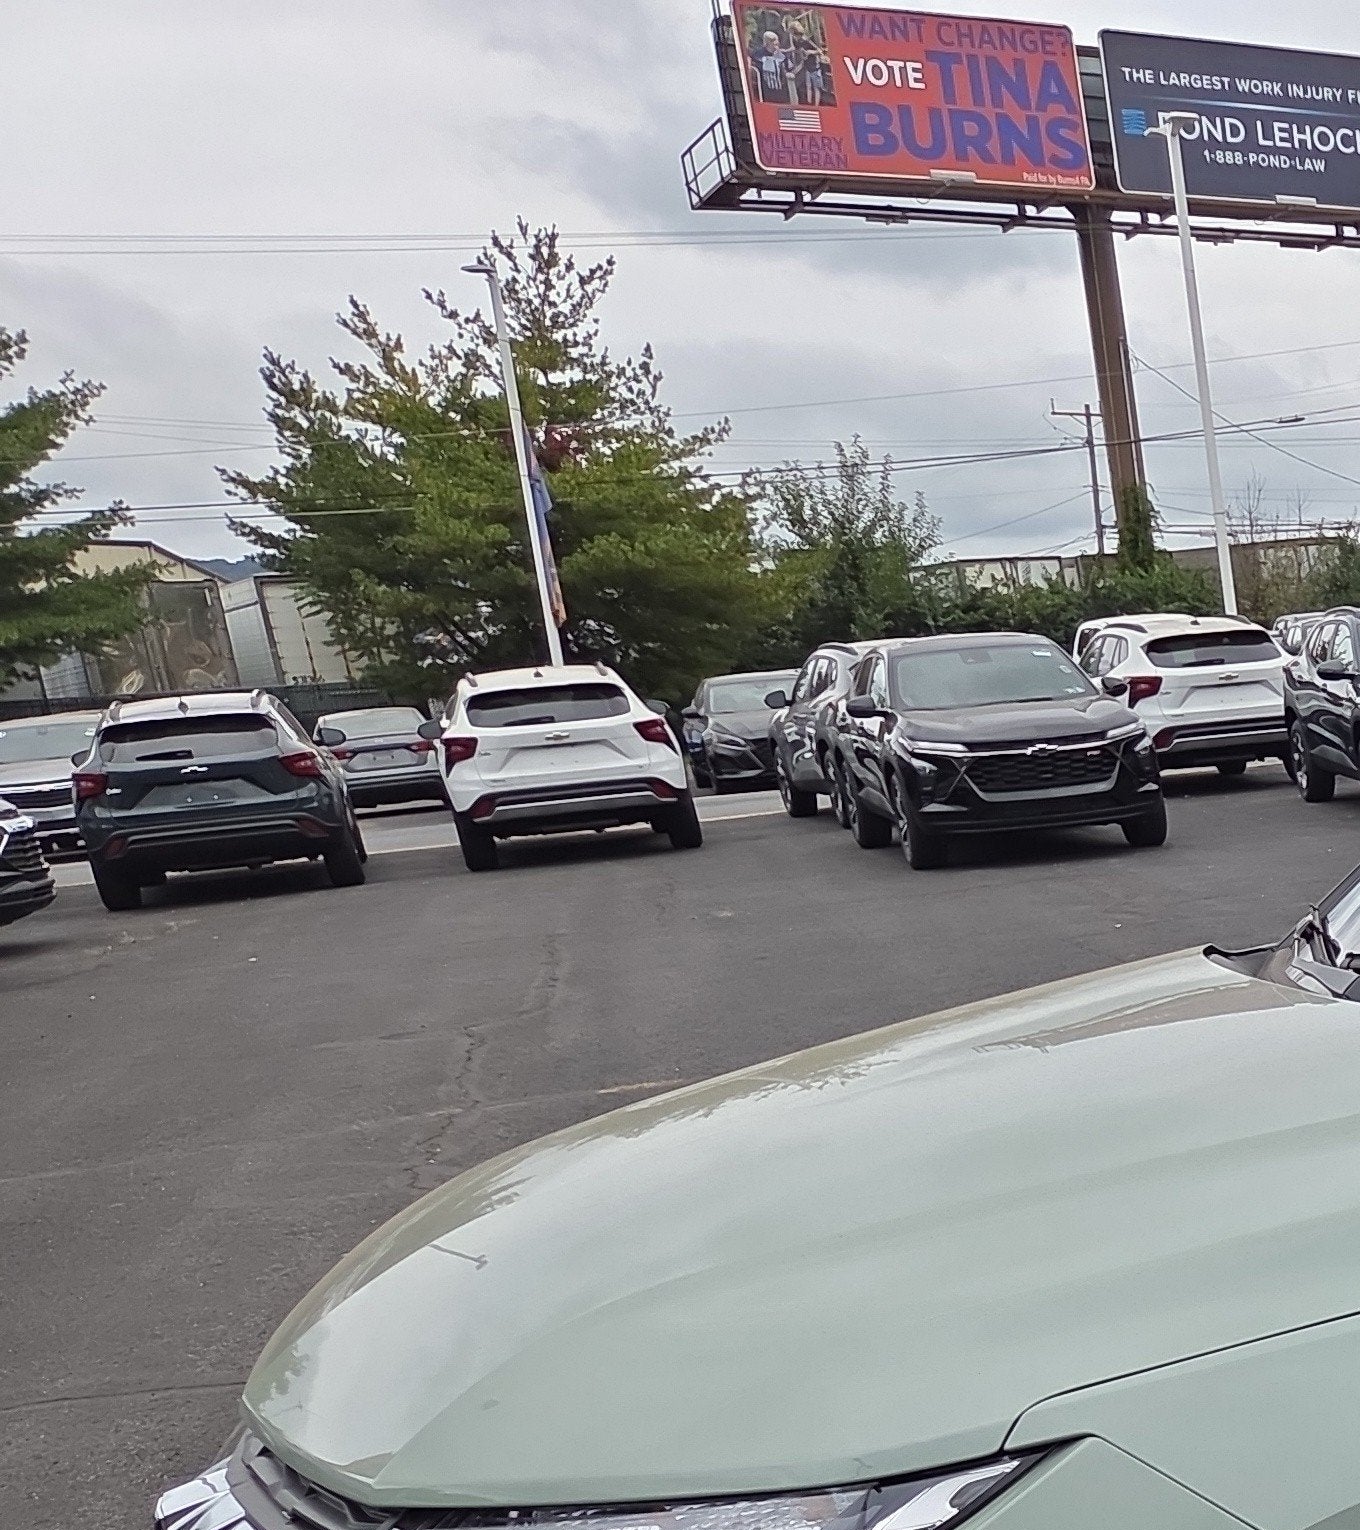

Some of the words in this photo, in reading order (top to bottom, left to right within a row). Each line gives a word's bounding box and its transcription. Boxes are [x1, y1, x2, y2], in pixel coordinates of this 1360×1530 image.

[836, 11, 926, 44] WANT
[936, 22, 1070, 56] CHANGE?
[843, 56, 926, 90] VOTE
[925, 51, 1078, 115] TINA
[1121, 67, 1154, 84] THE
[1159, 70, 1231, 91] LARGEST
[1235, 77, 1284, 97] WORK
[1288, 83, 1343, 103] INJURY
[760, 132, 844, 152] MILITARY
[850, 101, 1086, 171] BURNS
[761, 149, 848, 169] VETERAN
